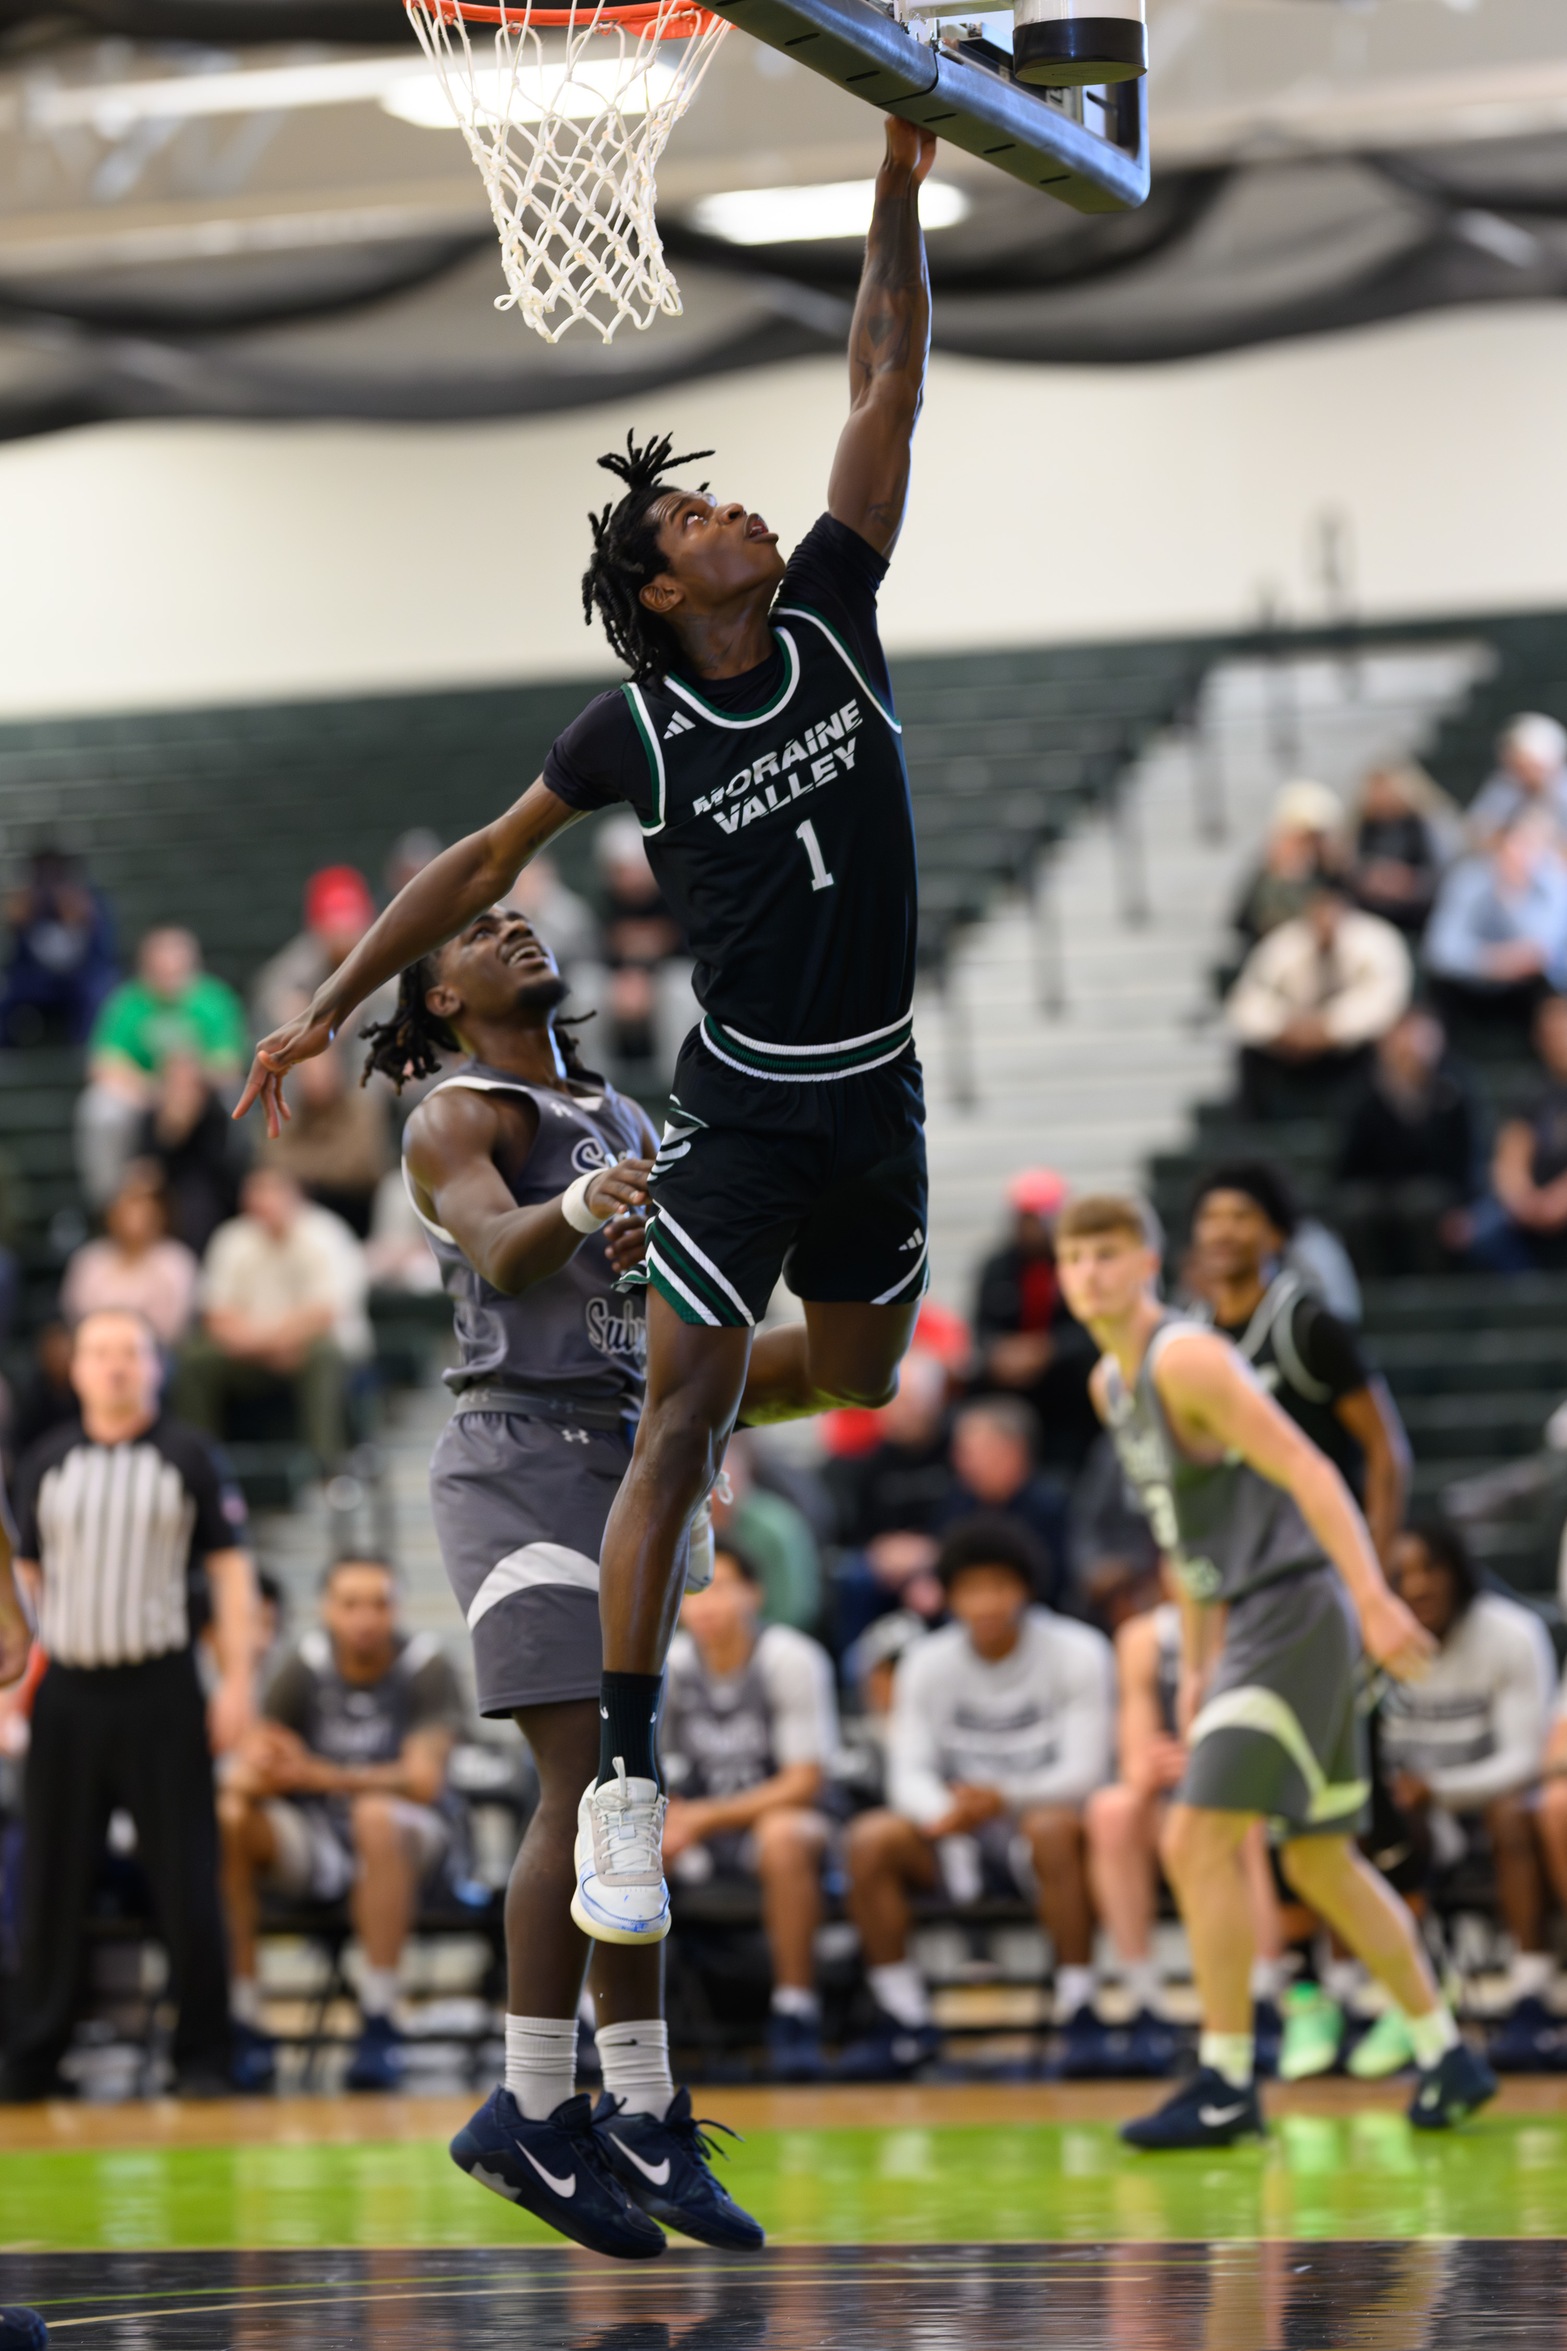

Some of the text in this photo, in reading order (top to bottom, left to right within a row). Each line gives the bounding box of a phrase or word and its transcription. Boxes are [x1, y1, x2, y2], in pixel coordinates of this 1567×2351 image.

[692, 698, 864, 817] MORAINE
[712, 737, 857, 835] VALLEY
[795, 818, 834, 892] 1
